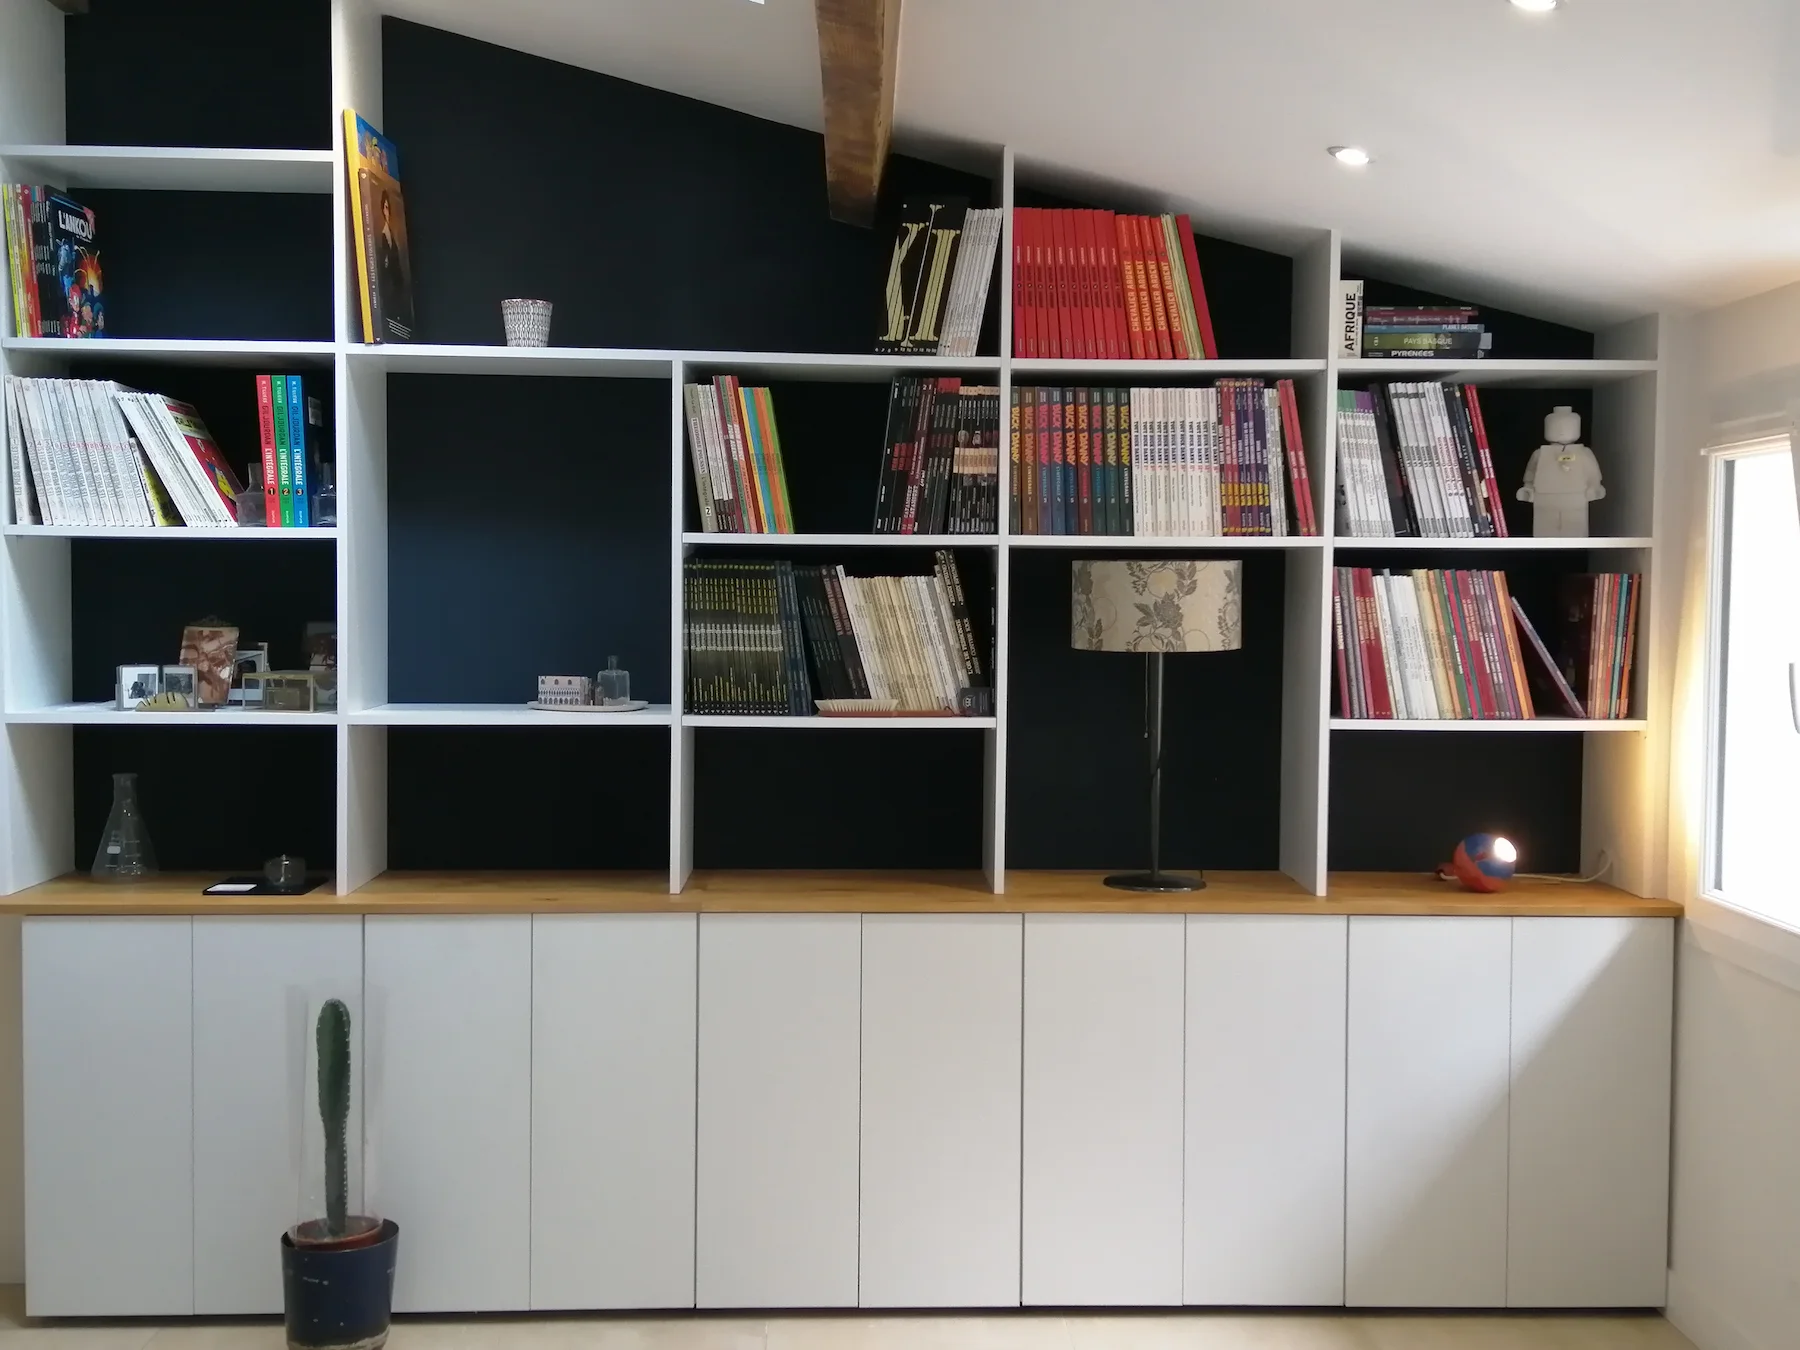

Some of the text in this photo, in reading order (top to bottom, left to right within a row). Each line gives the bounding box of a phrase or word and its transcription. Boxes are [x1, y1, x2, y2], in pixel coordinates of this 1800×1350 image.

[58, 210, 93, 240] L'ANKOU
[1124, 260, 1139, 331] CHEVALIER ARDENT
[1136, 260, 1152, 331] CHEVALIER ARDENT
[1147, 260, 1166, 331] CHEVALIER ARDENT
[1161, 261, 1180, 331] CHEVALIER ARDENT
[1344, 293, 1356, 351] AFRIQUE
[277, 417, 286, 445] JOURDAN
[1025, 406, 1033, 429] BUCK
[1040, 404, 1048, 428] BUCK
[1053, 404, 1061, 427] BUCK
[1121, 405, 1129, 429] BUCK
[1012, 431, 1020, 463] DANNY
[1040, 432, 1048, 464] DANNY
[1053, 431, 1061, 464] DANNY
[1066, 404, 1075, 465] BUCK DANNY
[1079, 404, 1088, 465] BUCK DANNY
[1093, 405, 1102, 465] BUCK DANNY
[1107, 405, 1116, 465] BUCK DANNY
[1121, 432, 1130, 465] DANNY
[265, 448, 274, 484] L'INTÉGRALE
[280, 448, 289, 484] L'INTÉGRALE
[294, 448, 303, 485] L'INTÉGRALE
